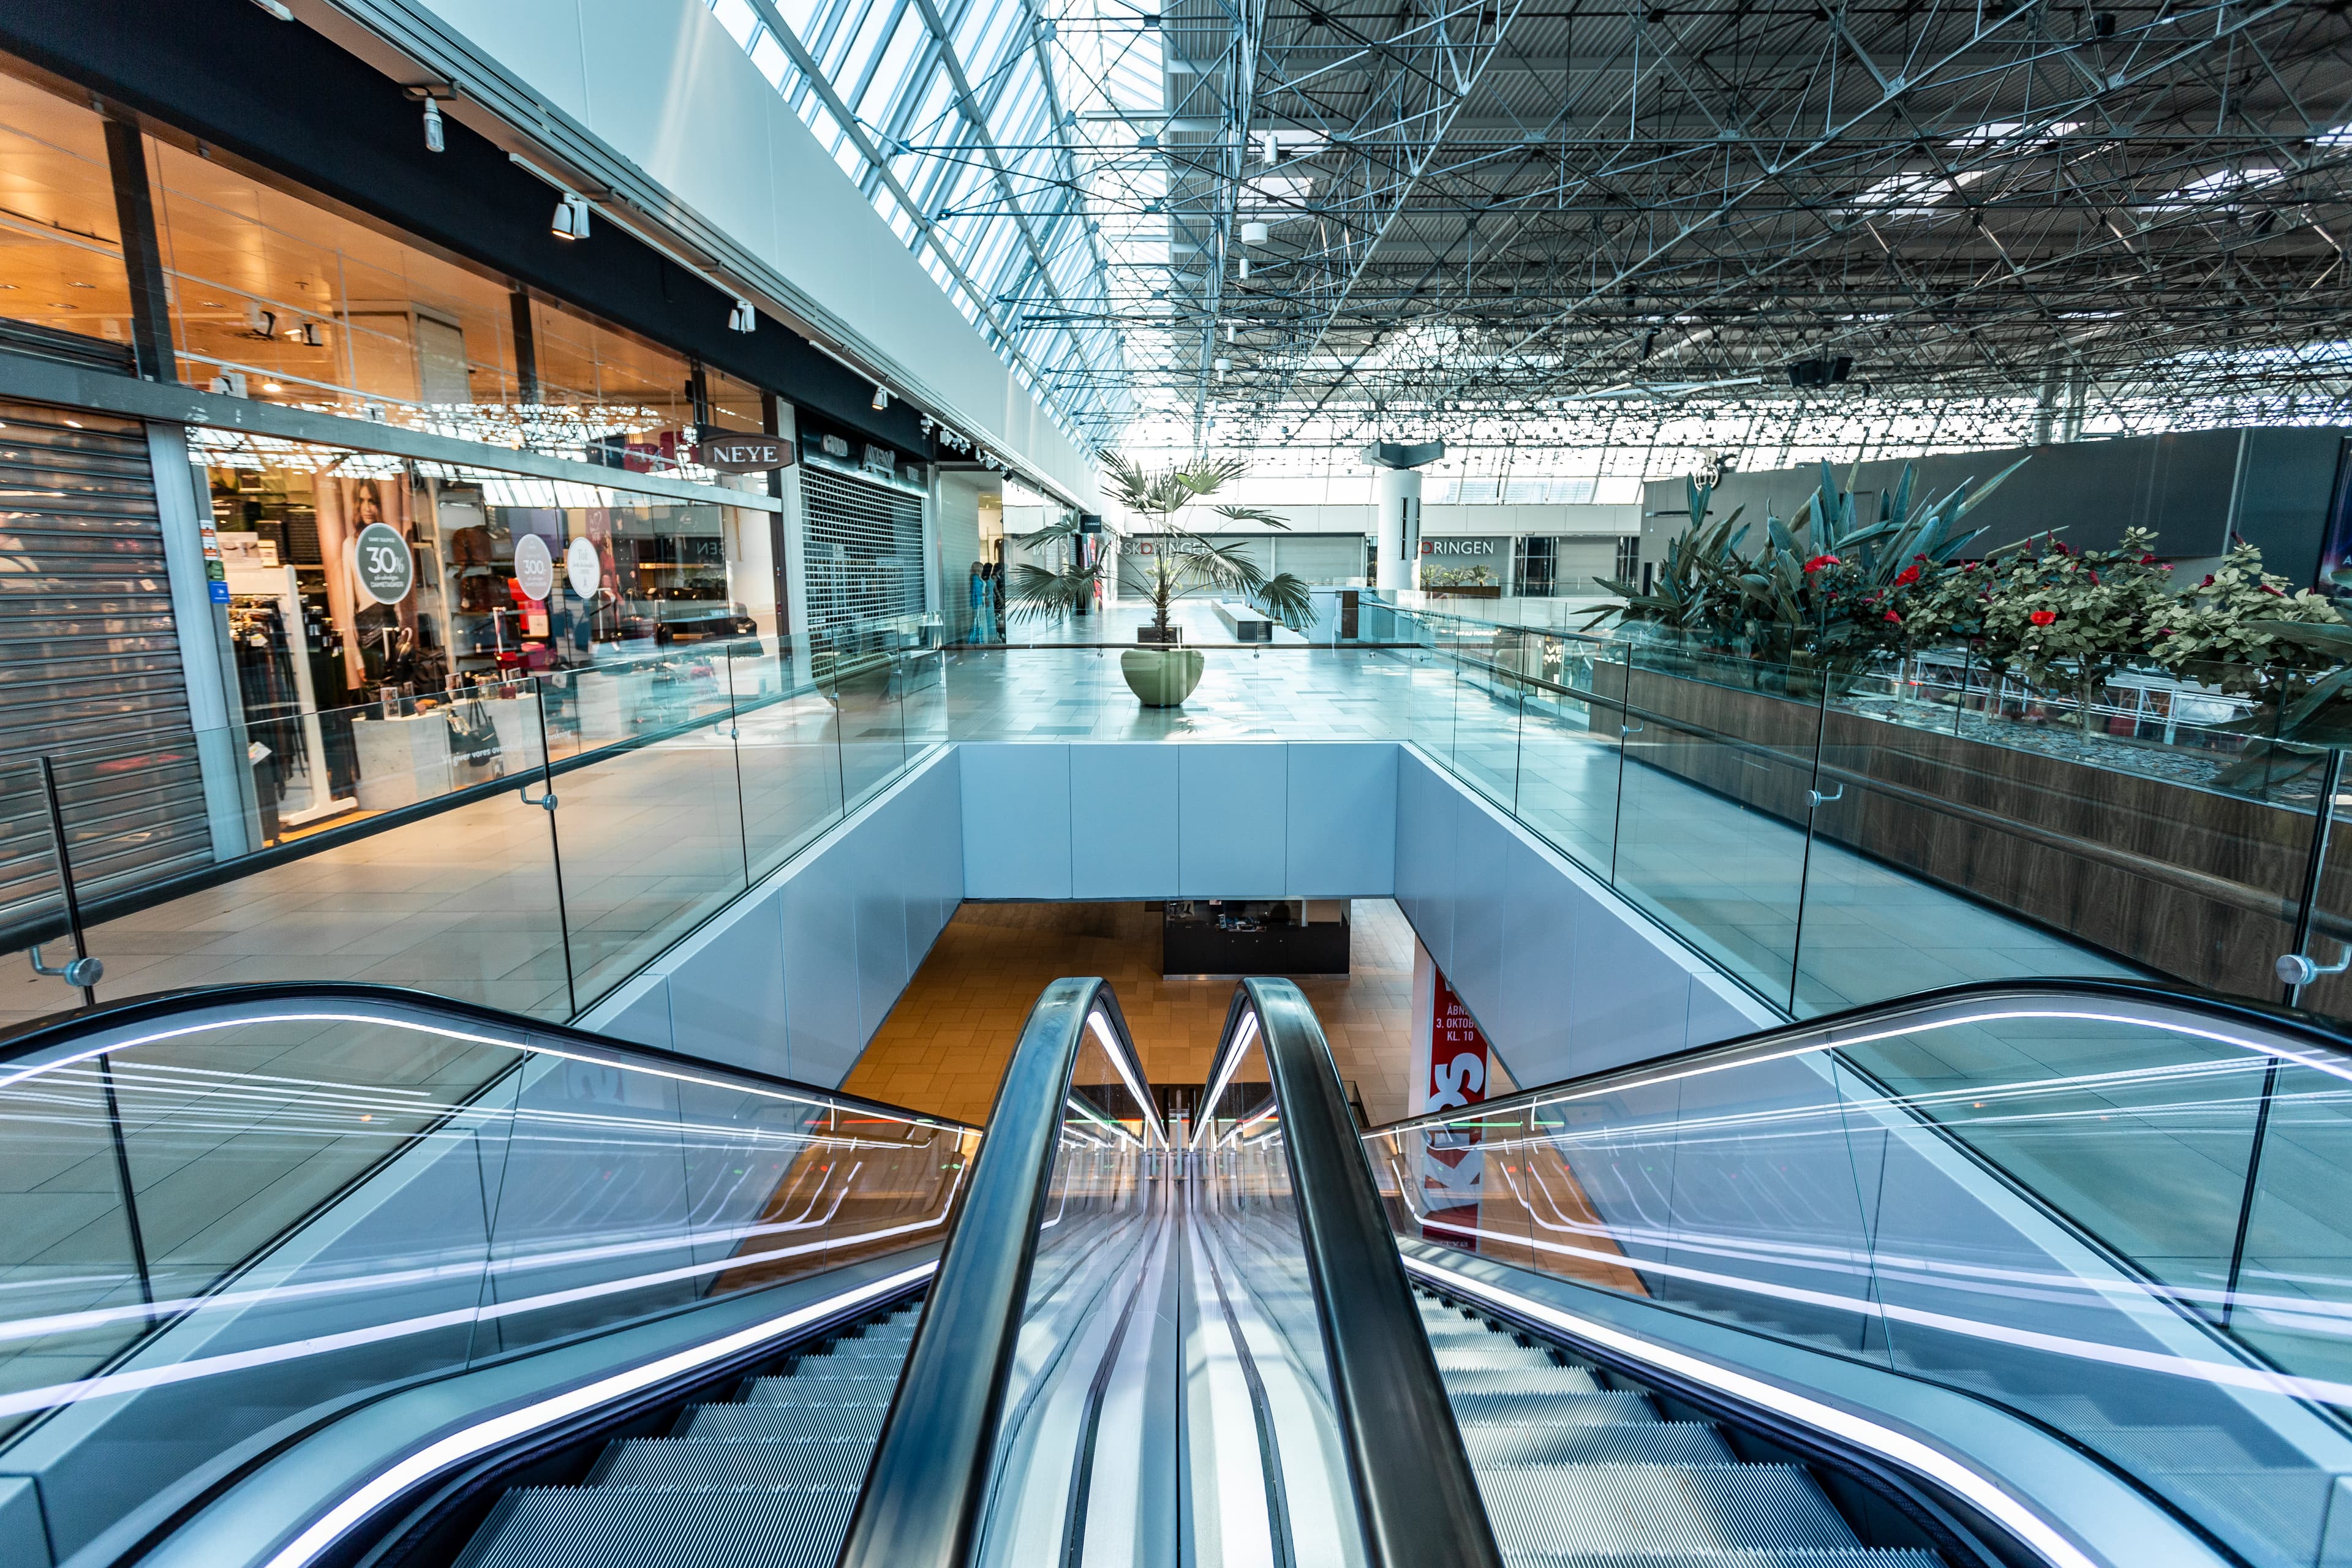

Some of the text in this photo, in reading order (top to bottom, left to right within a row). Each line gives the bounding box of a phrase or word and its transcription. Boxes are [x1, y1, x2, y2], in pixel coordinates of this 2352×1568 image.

[713, 447, 778, 463] NEYE
[366, 546, 405, 574] 30%
[453, 753, 470, 766] giver
[471, 748, 491, 758] vores
[1447, 1003, 1470, 1016] ÅBN
[1436, 1018, 1476, 1028] 3. OKTOB
[1447, 1031, 1474, 1041] KL. 10
